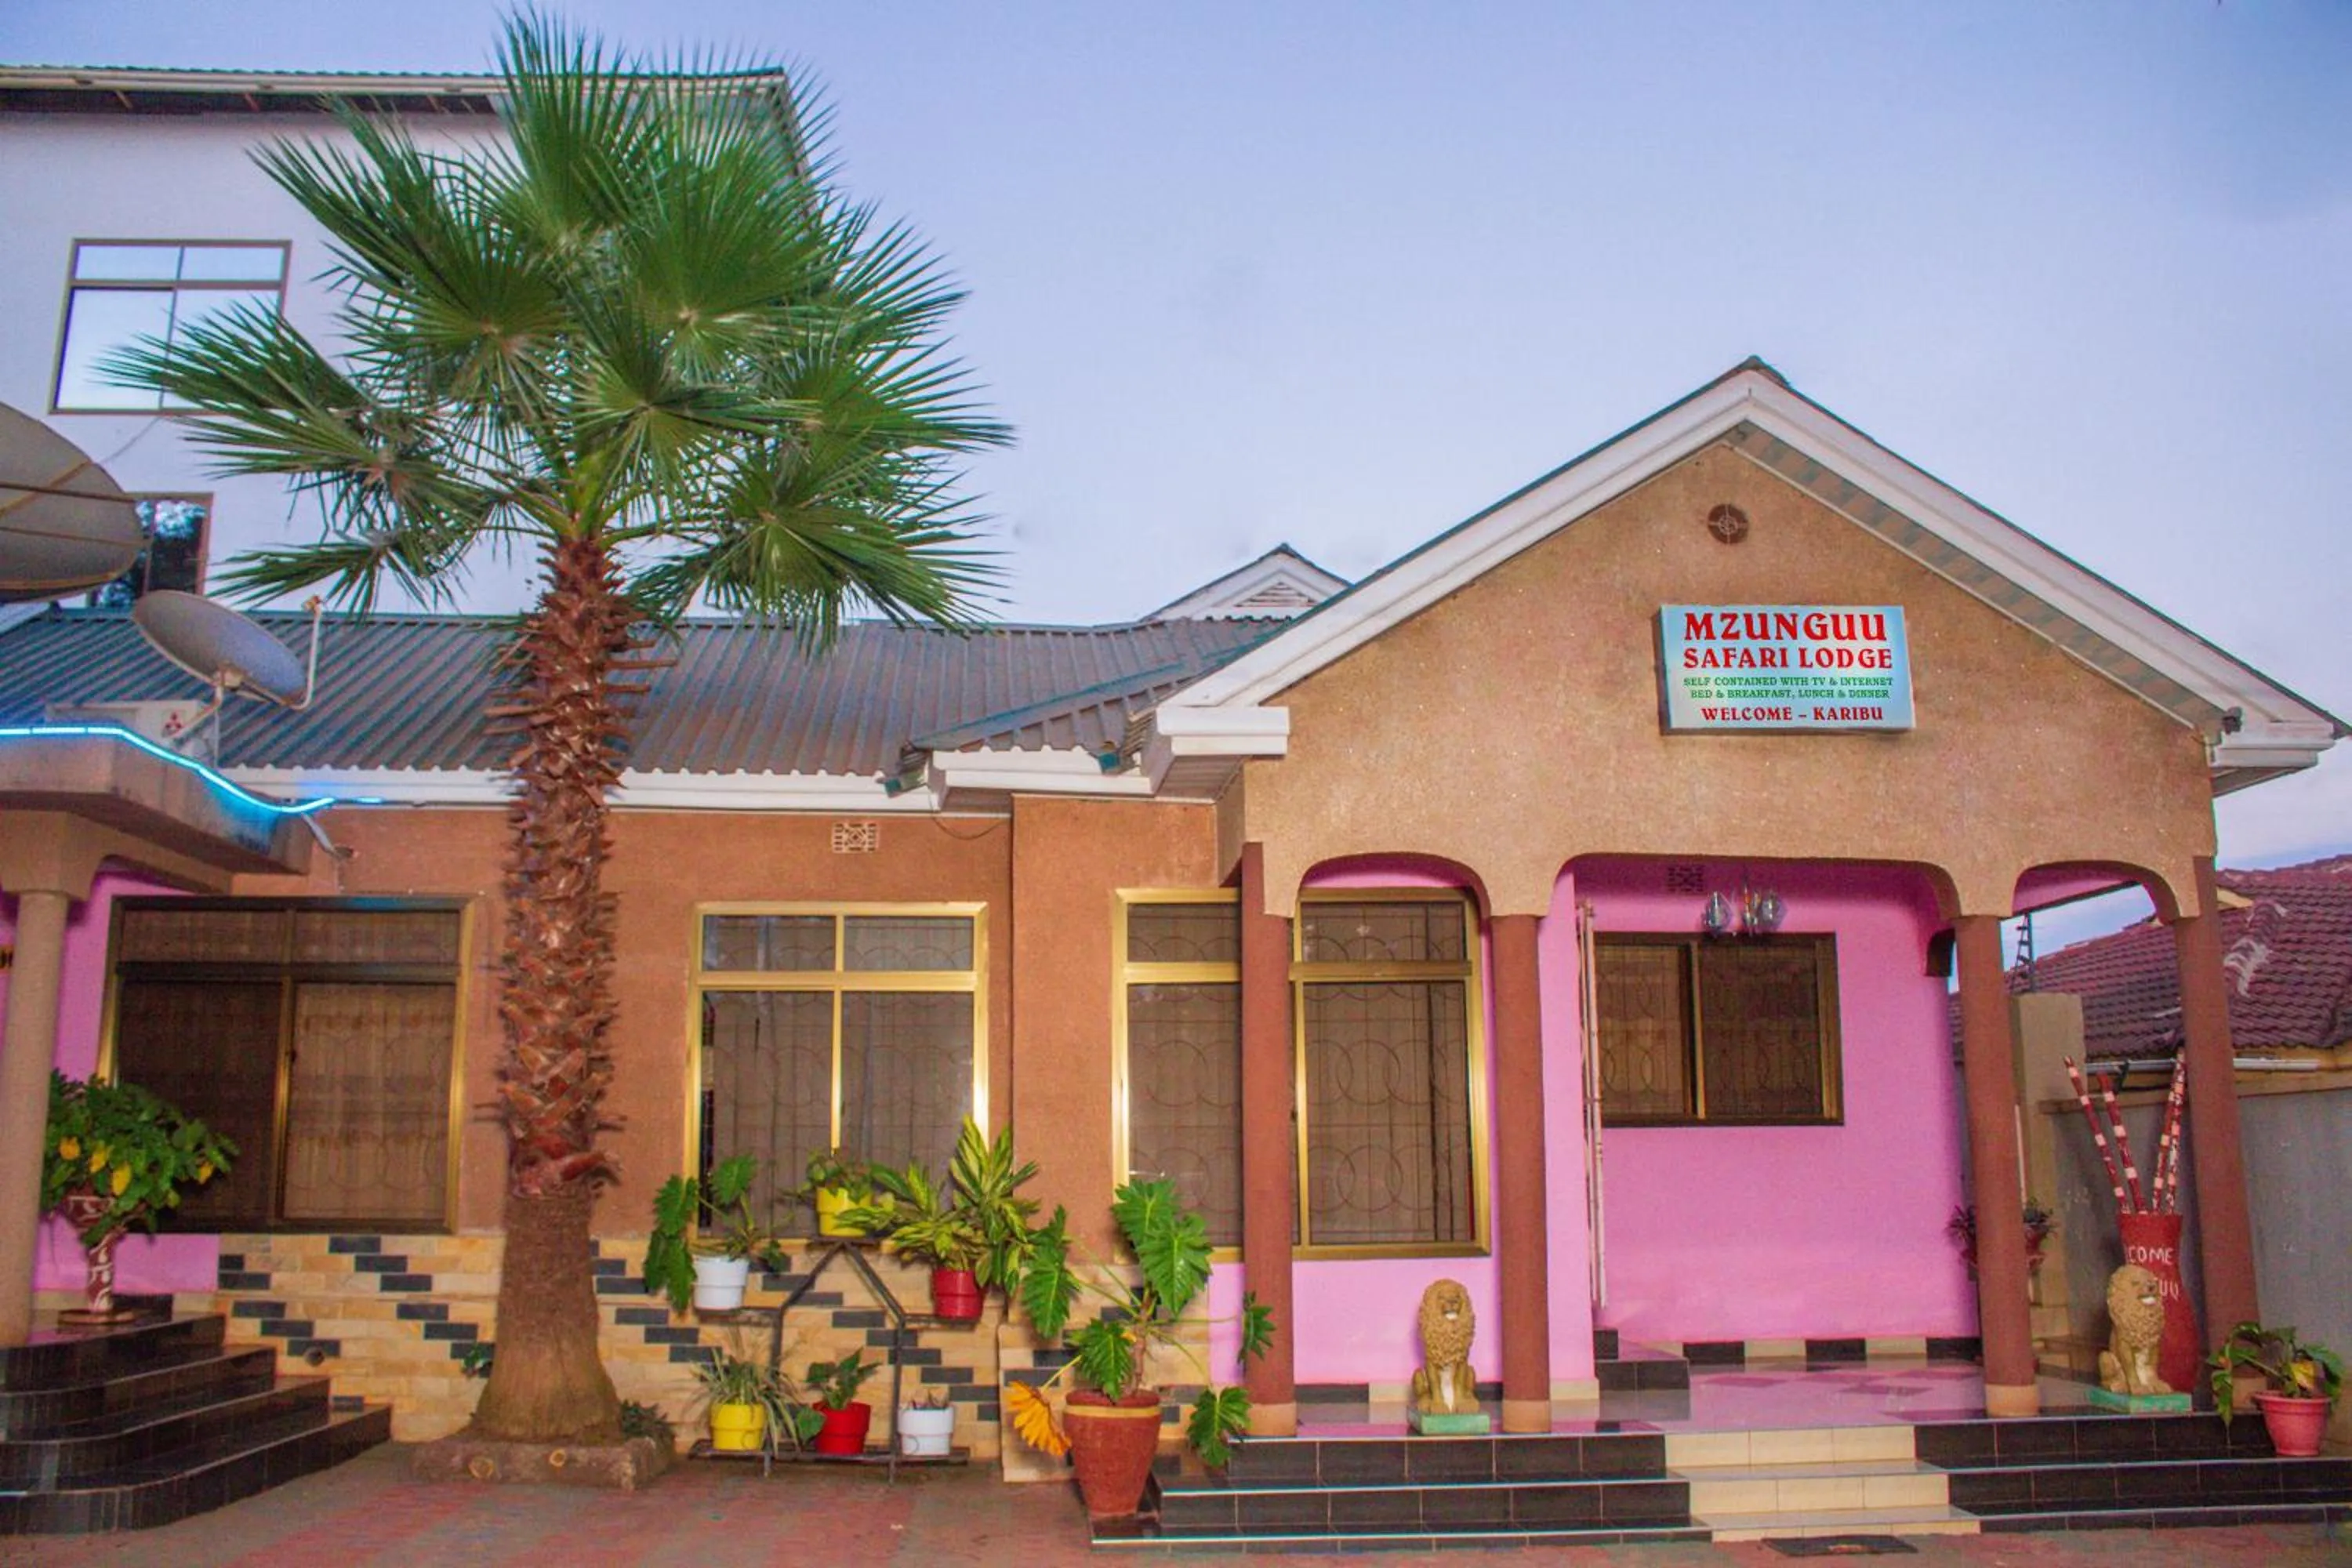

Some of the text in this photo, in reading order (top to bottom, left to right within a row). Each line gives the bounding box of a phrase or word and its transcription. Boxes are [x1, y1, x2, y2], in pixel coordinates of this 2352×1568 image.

[1684, 612, 1887, 641] MZUNGUU
[1683, 647, 1893, 669] SAFARI LODGE
[1683, 677, 1893, 686] SELF CONTAINED WITH TV & INTERNET
[1691, 689, 1890, 699] BED & BREAKFAST, LUNCH & DINNER
[1700, 706, 1793, 721] WELCOME
[1813, 706, 1883, 721] KARIBU
